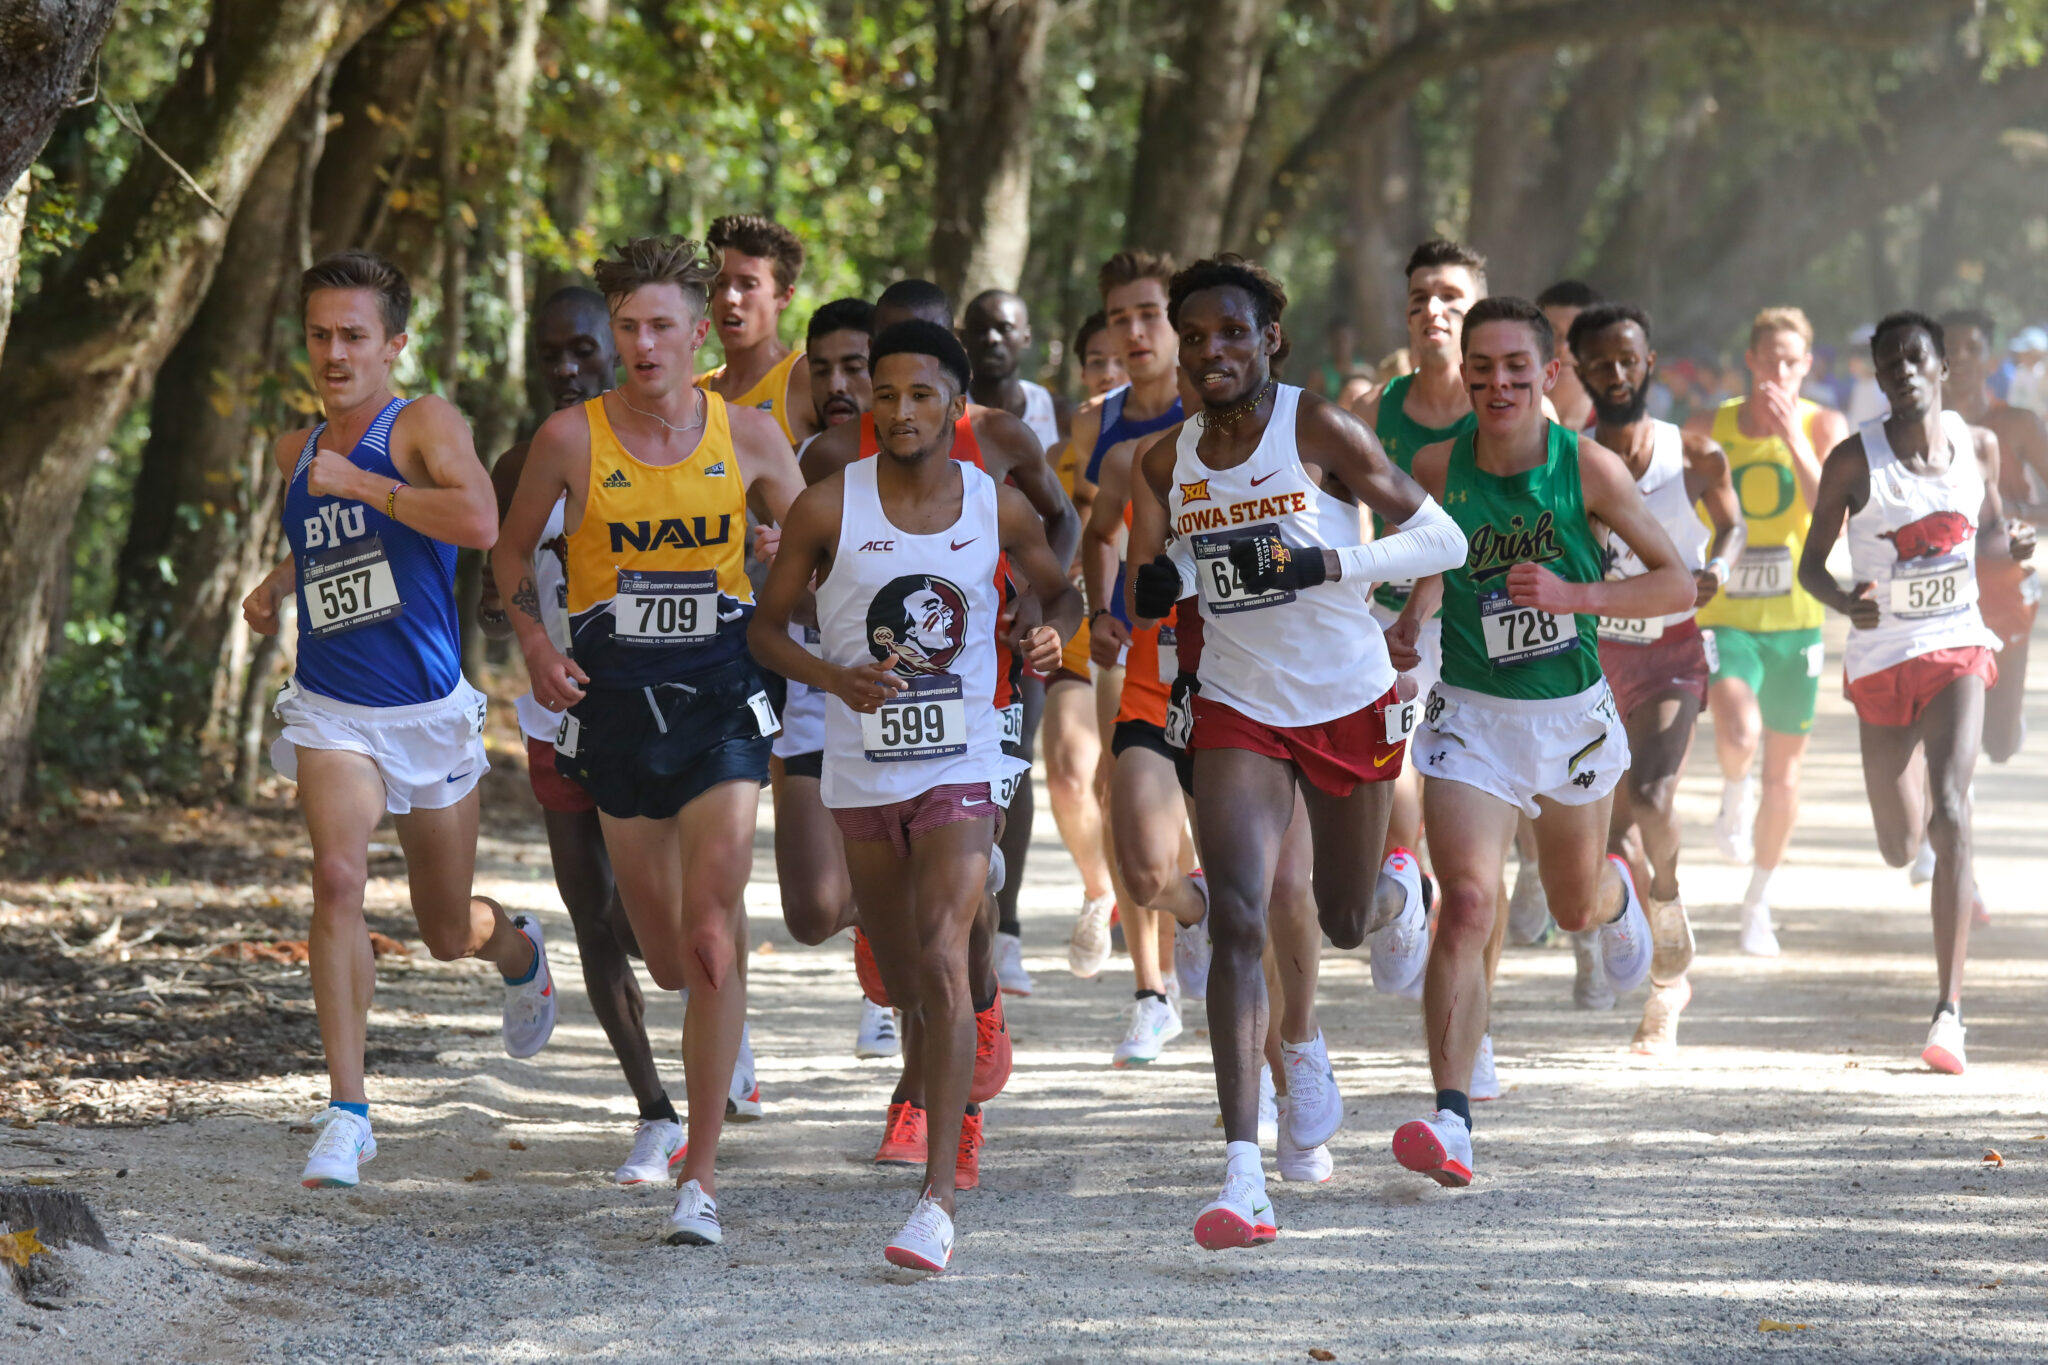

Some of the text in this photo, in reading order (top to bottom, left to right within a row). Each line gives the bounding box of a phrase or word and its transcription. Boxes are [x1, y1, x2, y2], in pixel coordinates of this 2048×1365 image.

[304, 502, 365, 548] BYU
[1178, 492, 1307, 535] IOWA STATE
[606, 514, 731, 552] NAU
[858, 541, 895, 551] ACC
[1469, 510, 1564, 572] Irish
[1262, 537, 1270, 568] WESLEY
[318, 569, 372, 620] 557
[1738, 565, 1779, 589] 770
[1909, 576, 1955, 609] 528
[636, 597, 697, 633] 709
[1499, 609, 1559, 650] 728
[917, 687, 958, 697] CHAMPIONSHIPS
[881, 704, 945, 746] 599
